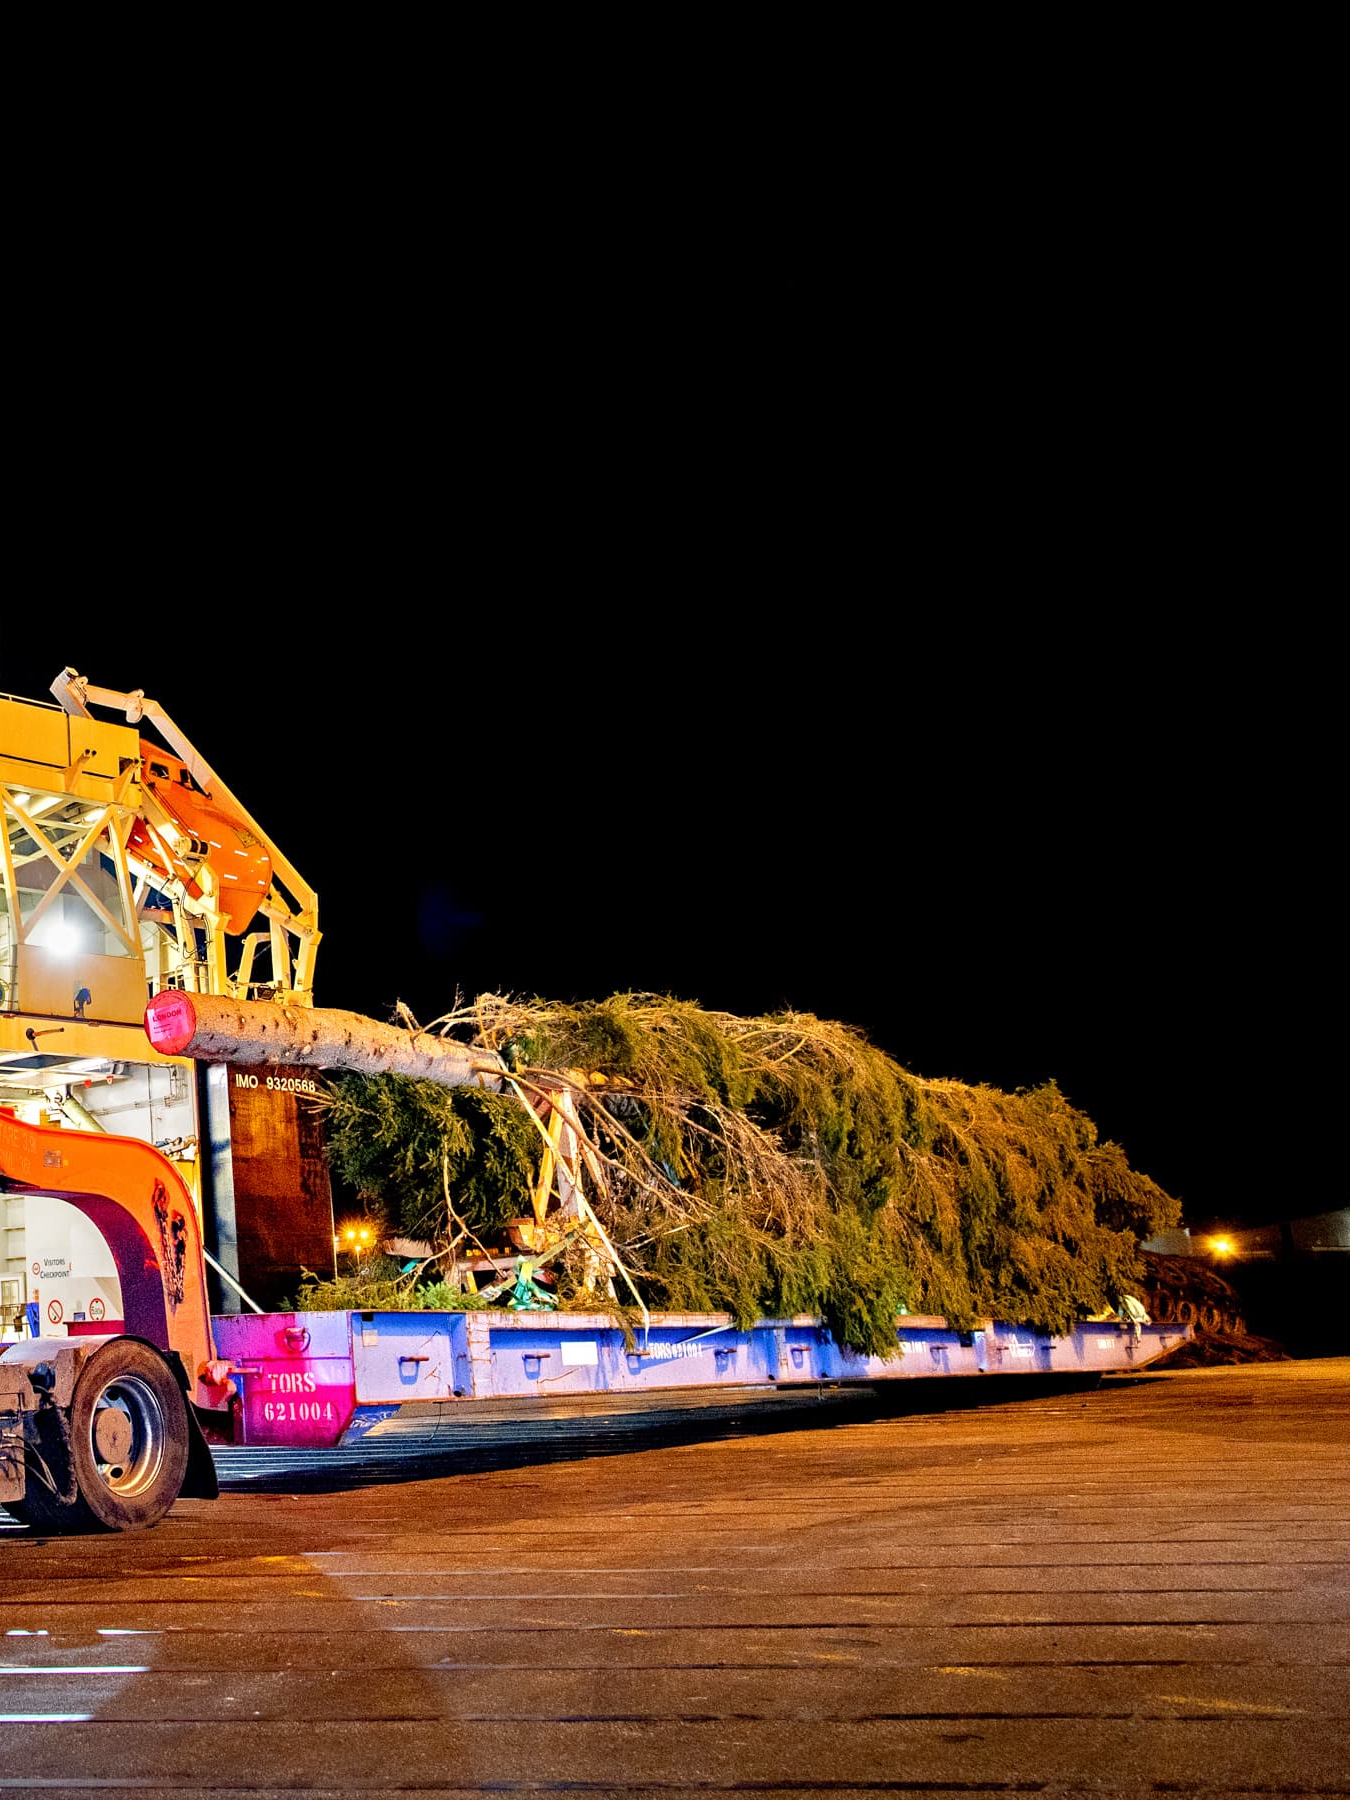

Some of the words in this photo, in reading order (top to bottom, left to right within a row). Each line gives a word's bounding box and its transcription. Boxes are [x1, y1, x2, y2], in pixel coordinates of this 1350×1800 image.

[152, 1008, 183, 1023] LONDON
[235, 1073, 259, 1089] IMO
[266, 1076, 317, 1093] 9320568
[267, 1371, 317, 1394] TORS
[264, 1401, 334, 1421] 621004
